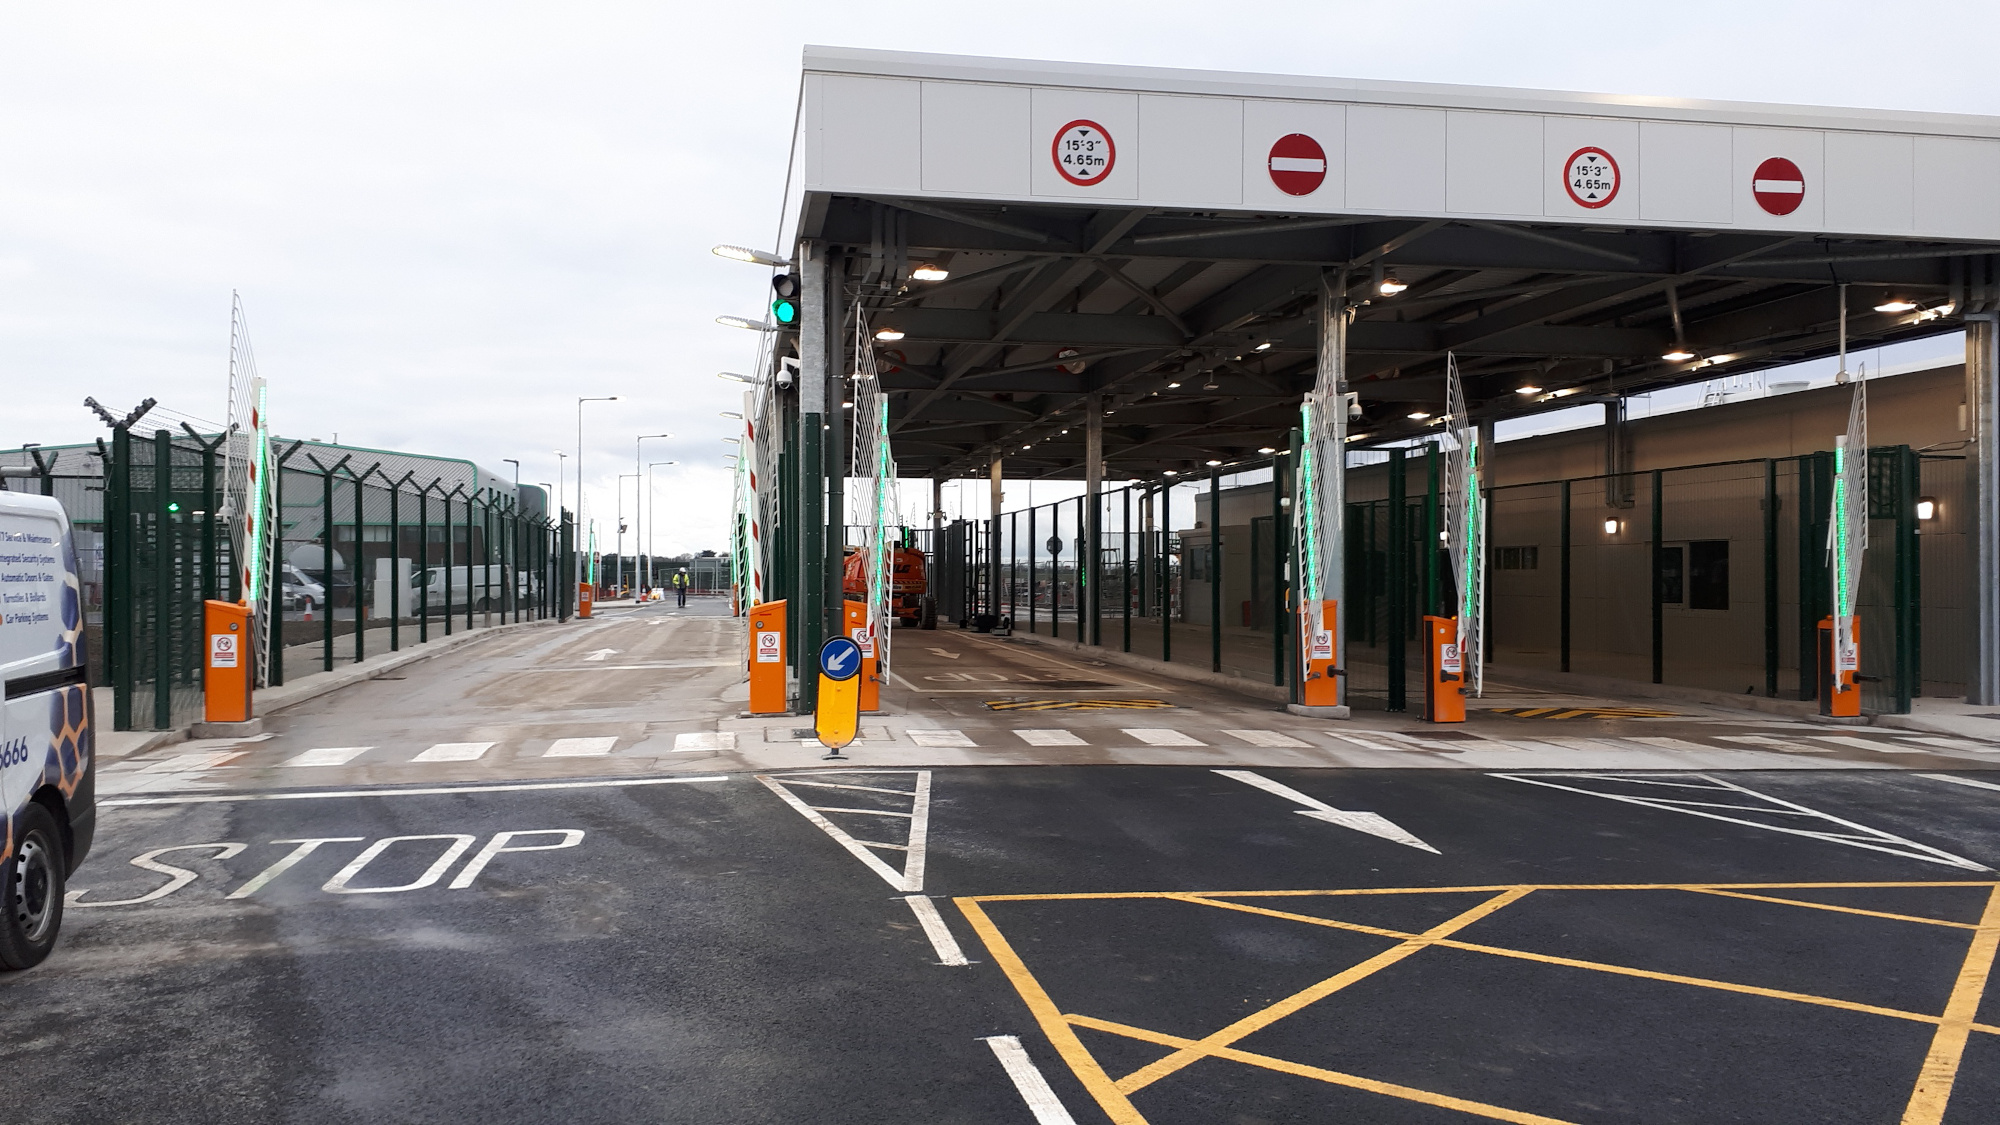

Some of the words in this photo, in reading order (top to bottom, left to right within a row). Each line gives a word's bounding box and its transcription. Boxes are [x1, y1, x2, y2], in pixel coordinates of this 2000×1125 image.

[1063, 154, 1105, 166] 4.65m
[1574, 178, 1611, 191] 4.65m
[26, 533, 52, 544] Maintenance
[0, 553, 21, 566] ntegrated
[22, 553, 39, 567] Security
[39, 553, 55, 567] Systems
[1, 572, 24, 582] Automatic
[25, 572, 38, 582] Doors
[42, 572, 54, 582] Gates
[6, 613, 15, 625] Car
[15, 612, 31, 625] Parking
[32, 611, 49, 625] Systems
[64, 829, 585, 907] STOP
